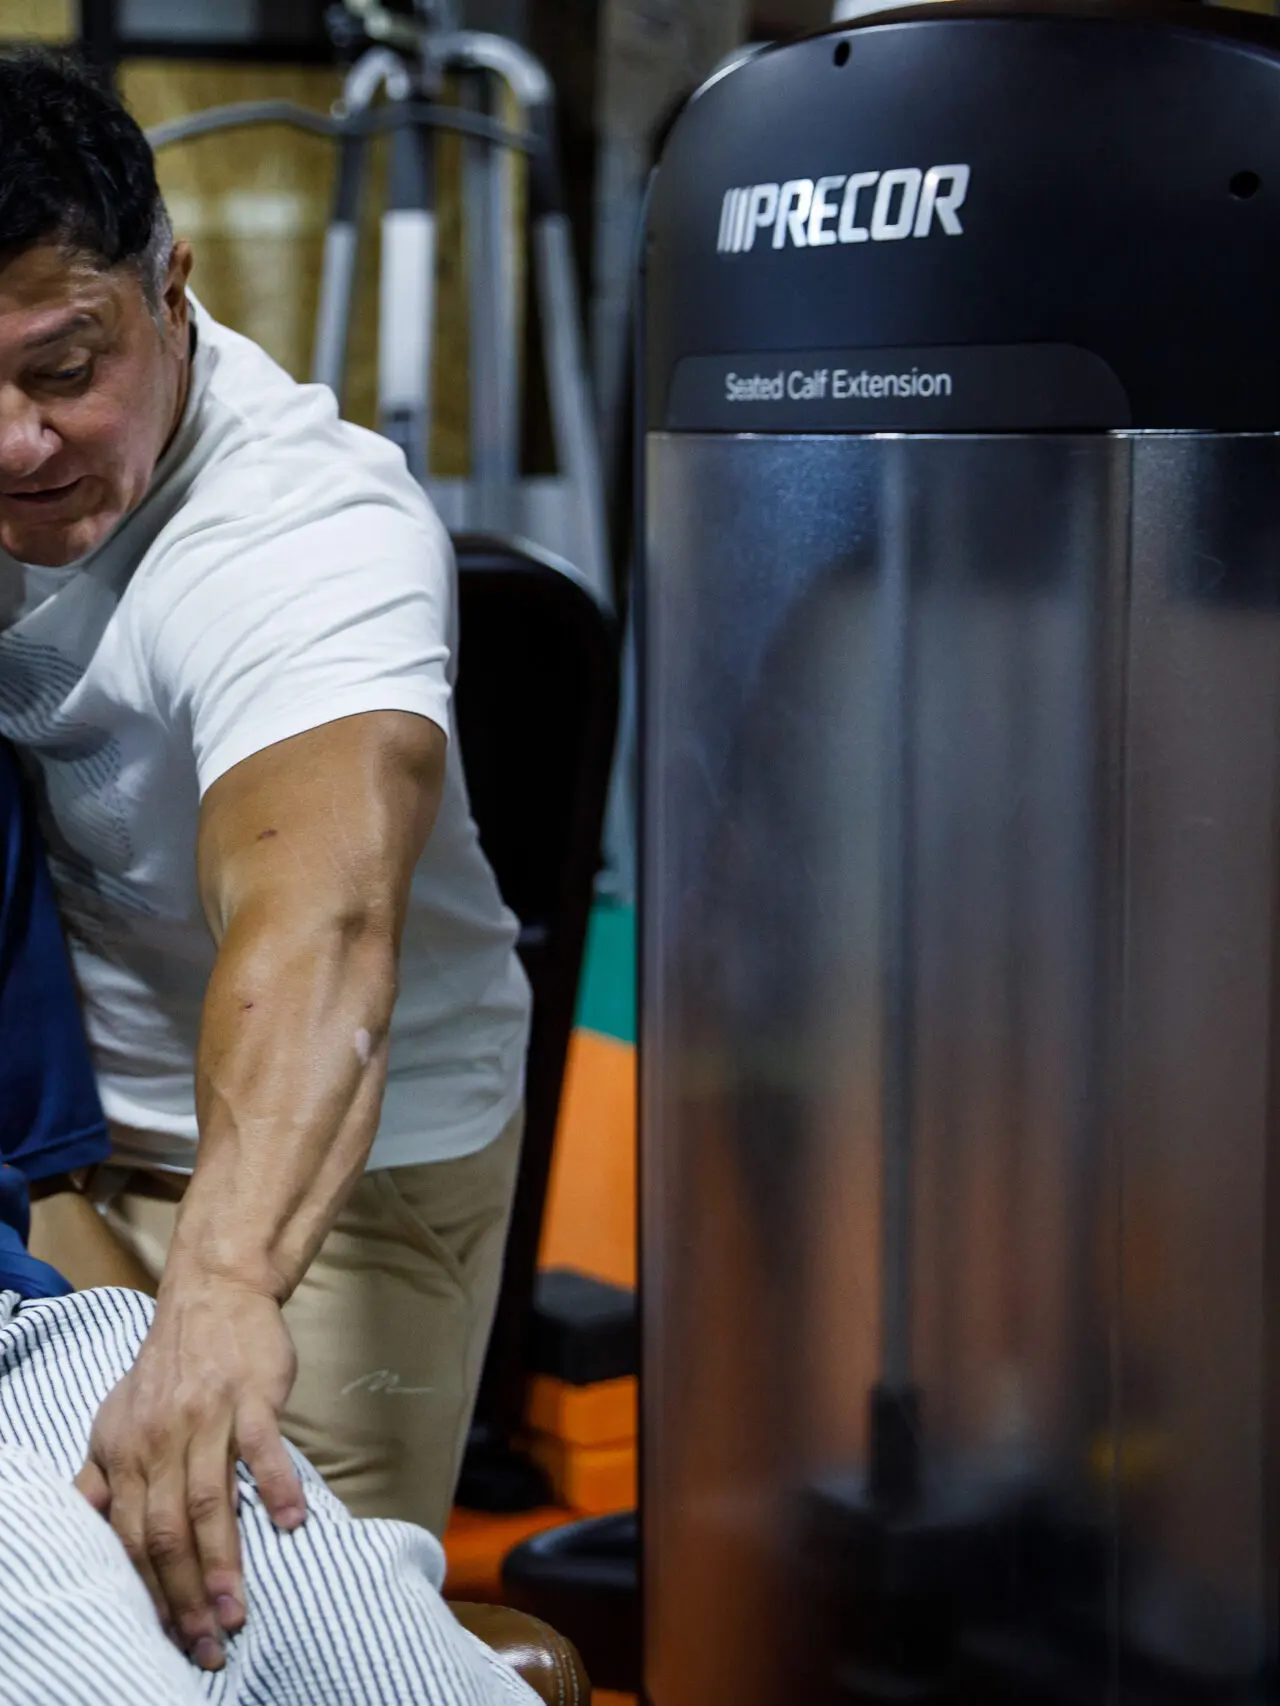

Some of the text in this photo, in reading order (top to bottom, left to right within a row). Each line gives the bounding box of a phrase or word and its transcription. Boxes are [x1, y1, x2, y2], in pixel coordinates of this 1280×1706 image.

[741, 164, 970, 252] PRECOR
[725, 367, 953, 401] Seated Calf Extension
